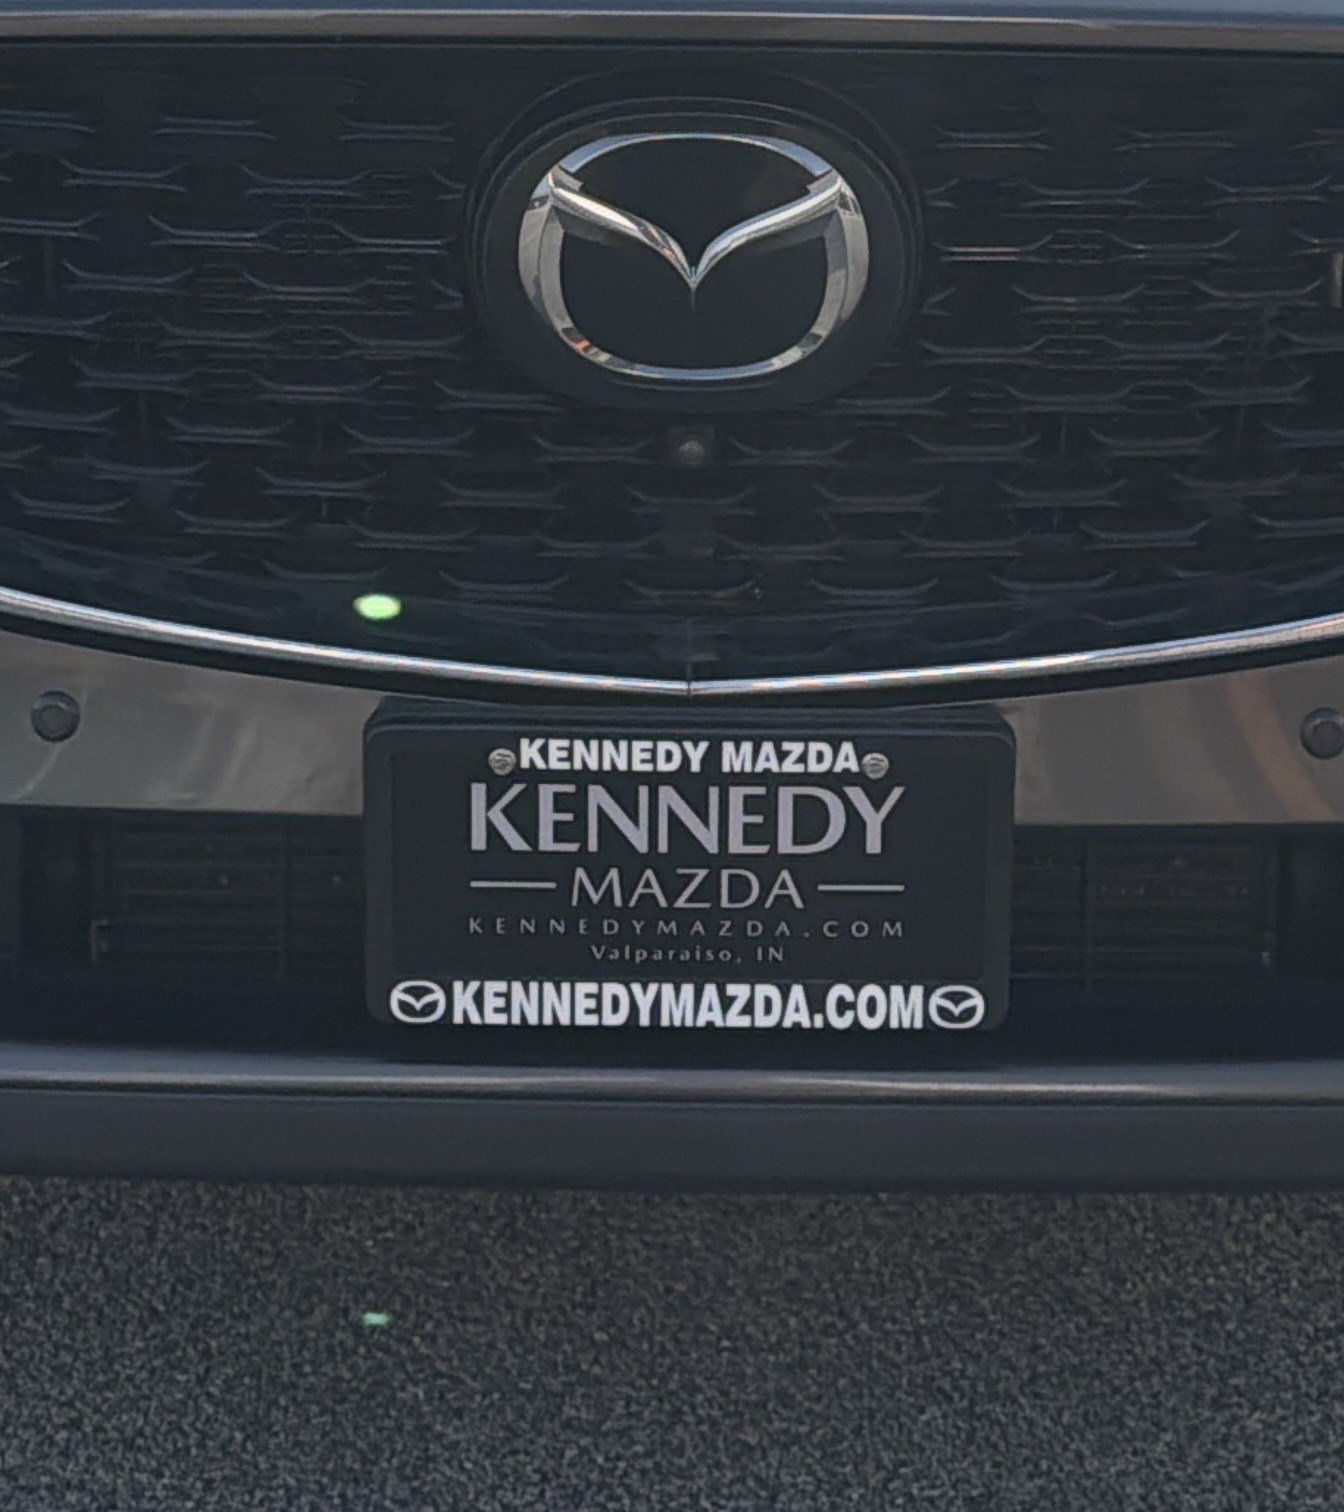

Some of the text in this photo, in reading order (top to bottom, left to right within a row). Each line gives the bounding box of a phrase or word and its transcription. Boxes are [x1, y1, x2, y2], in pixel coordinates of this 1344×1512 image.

[519, 737, 860, 774] KENNEDY MAZDA
[470, 783, 906, 855] KENNEDY
[570, 867, 805, 909] MAZDA
[468, 916, 905, 938] KENNEDYMAZDA.COM
[591, 944, 784, 964] Valparaiso, IN
[452, 980, 924, 1029] KENNEDYMAZDA.COM
